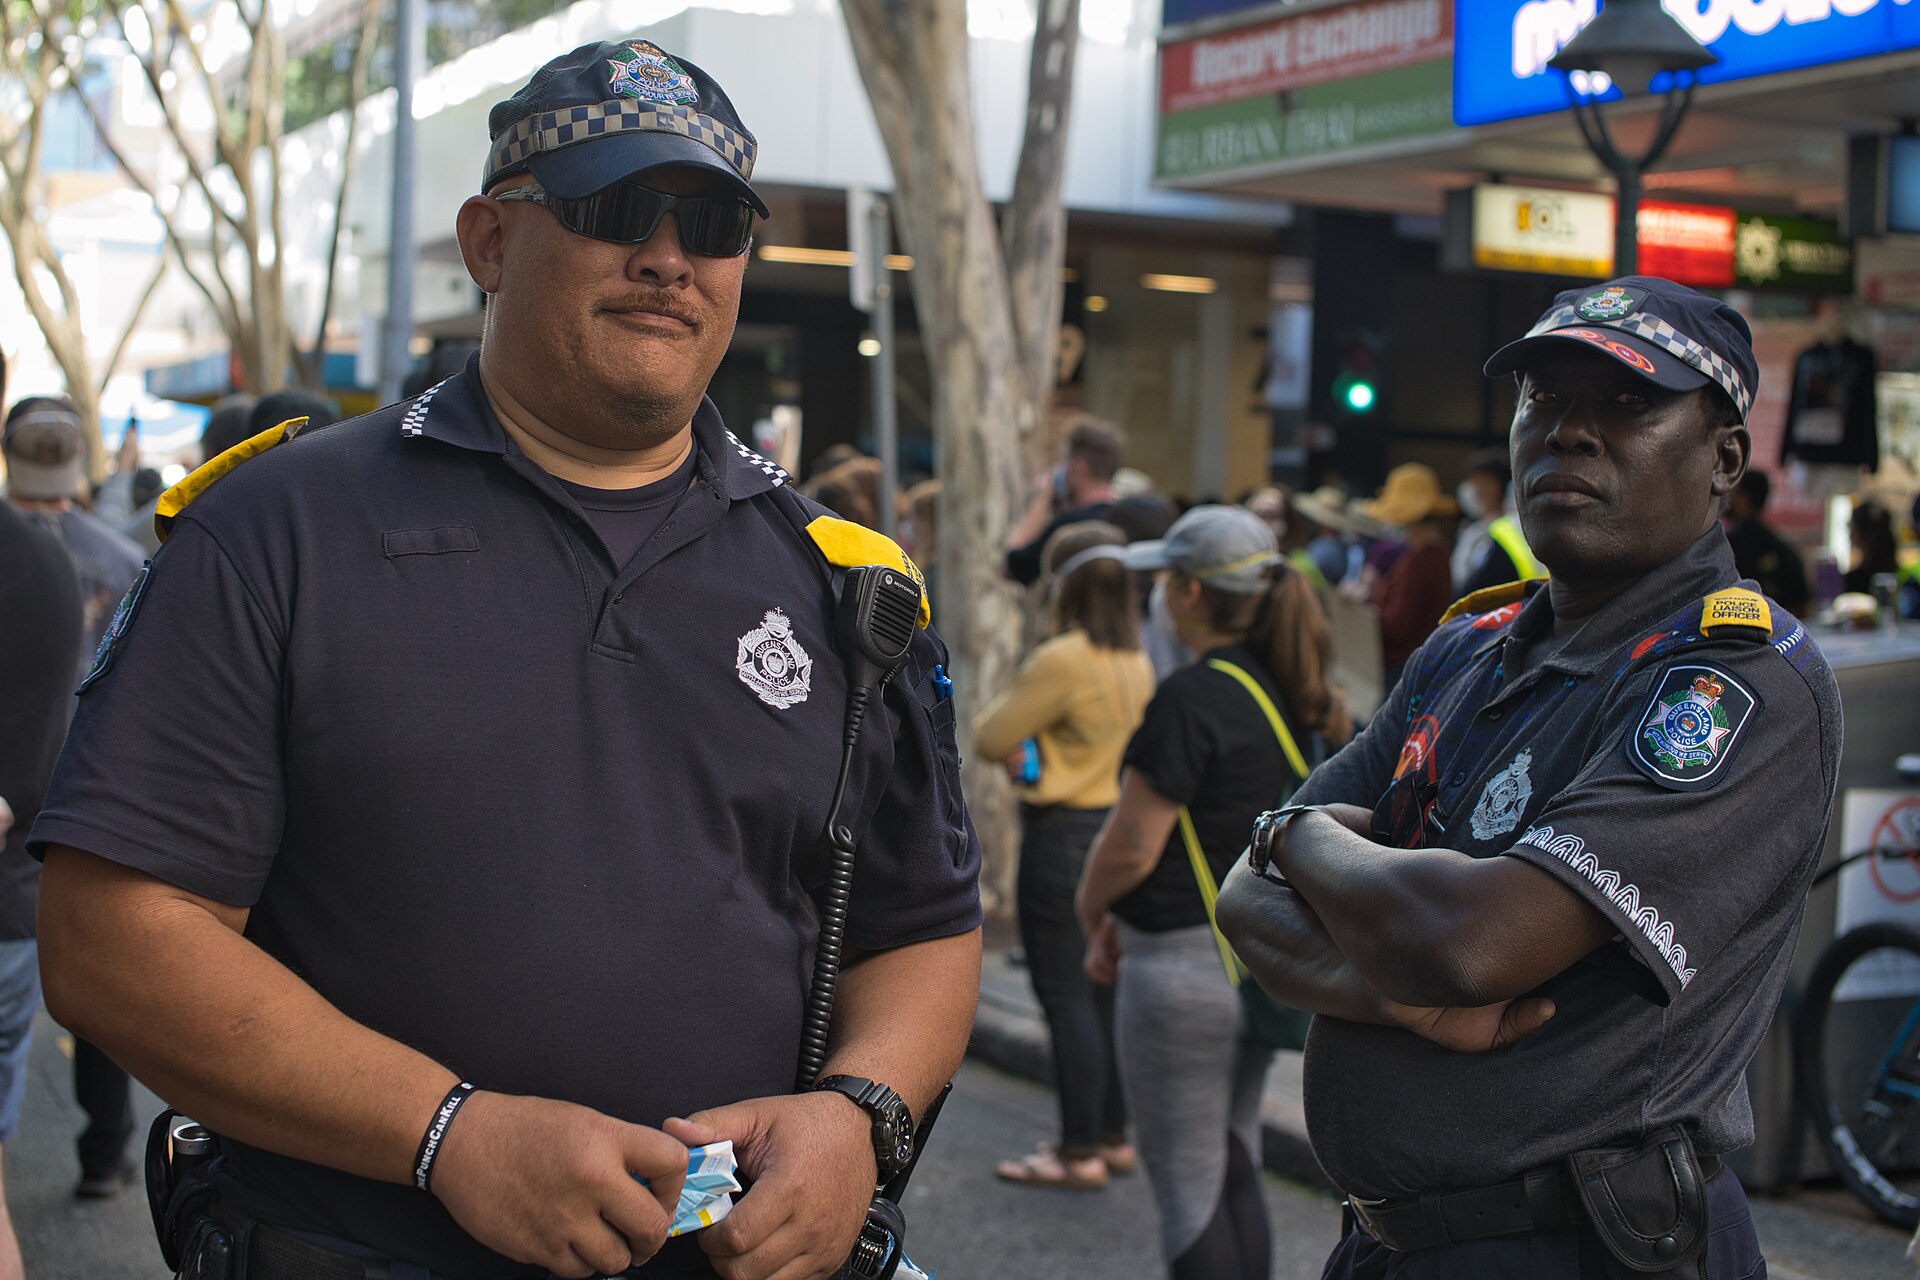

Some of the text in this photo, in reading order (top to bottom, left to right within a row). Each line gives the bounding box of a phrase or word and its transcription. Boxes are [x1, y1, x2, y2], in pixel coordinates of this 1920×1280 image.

[1191, 24, 1288, 87] Record
[1296, 0, 1441, 66] Exchange
[639, 79, 674, 89] POLICE
[894, 581, 918, 598] MOTOROLA
[1712, 611, 1761, 621] OFFICER
[1713, 605, 1760, 613] LIAISON
[755, 640, 796, 670] QUEENSLAND
[759, 668, 791, 687] POLICE
[1667, 702, 1710, 736] QUEENSLAND
[1667, 727, 1698, 746] POLICE
[1679, 751, 1688, 759] WE
